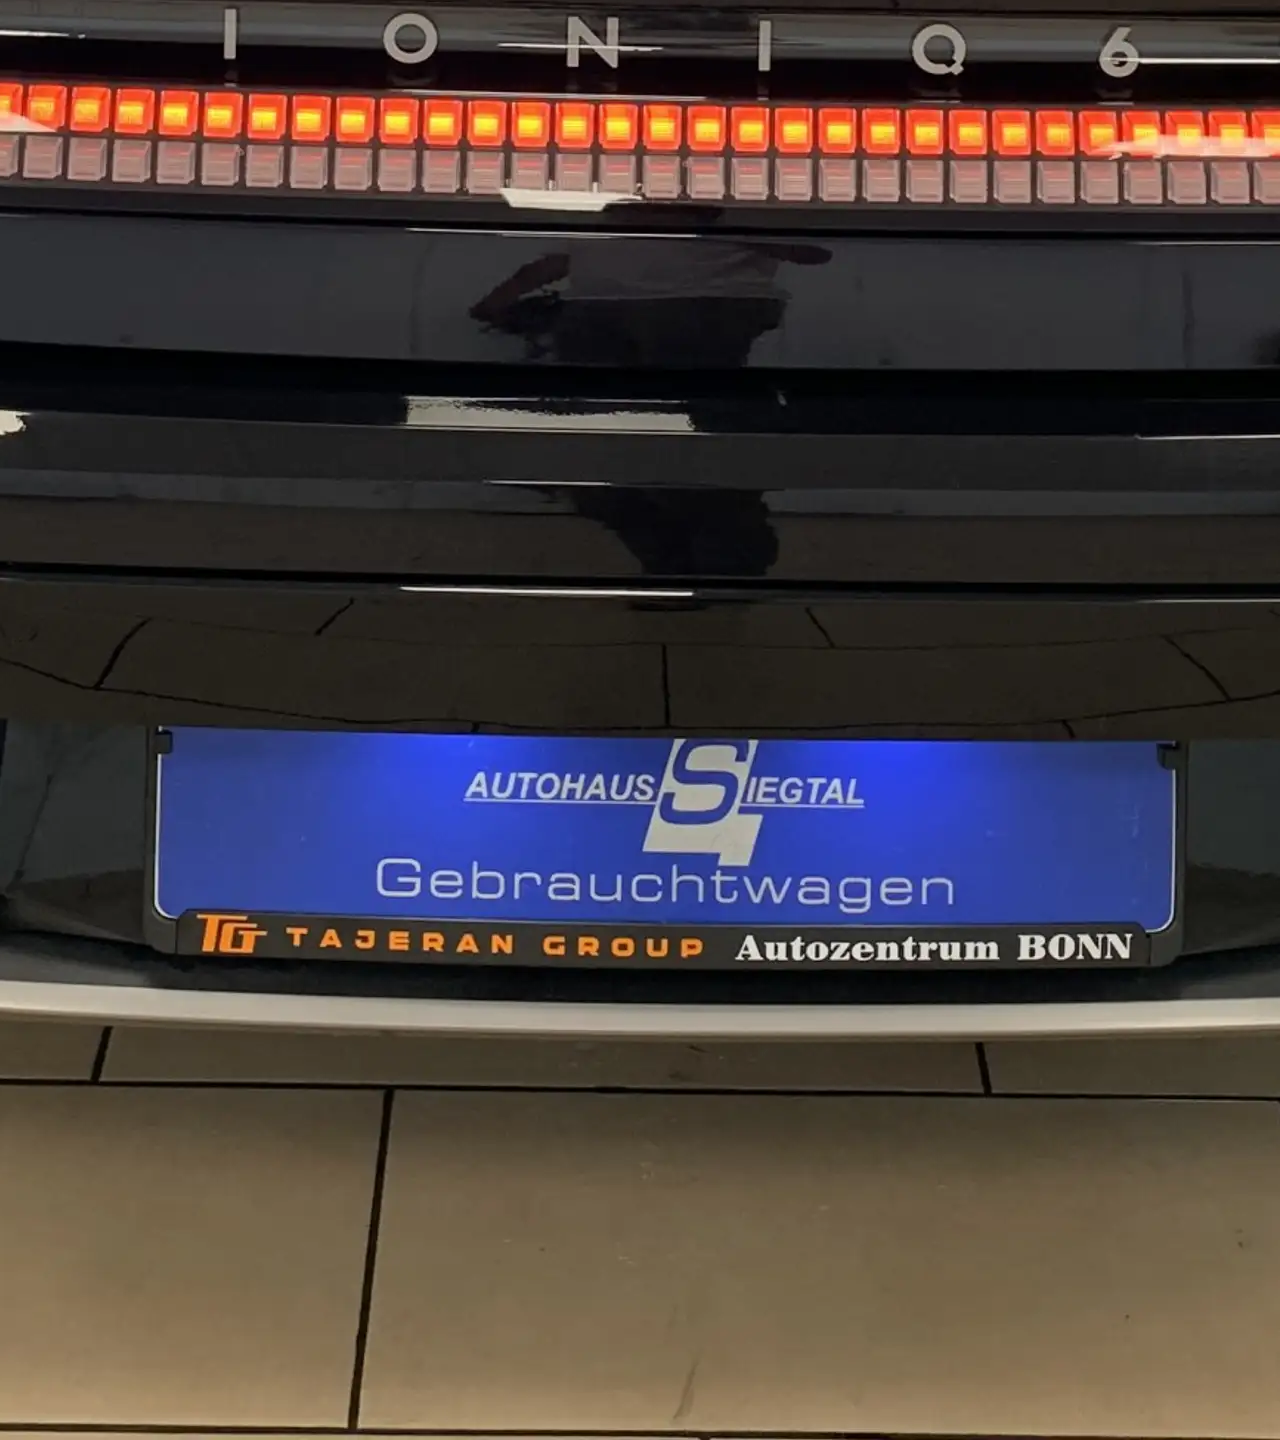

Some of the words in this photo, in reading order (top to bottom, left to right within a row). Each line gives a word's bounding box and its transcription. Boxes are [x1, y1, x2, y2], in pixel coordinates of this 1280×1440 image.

[1099, 26, 1139, 77] 6
[464, 771, 655, 803] AUTOHAUS
[376, 857, 955, 914] Gebrauchtwagen
[285, 927, 513, 954] TAJERAN
[543, 935, 703, 958] GROUP
[735, 934, 1001, 961] Autozentrum
[1017, 933, 1133, 960] BONN
